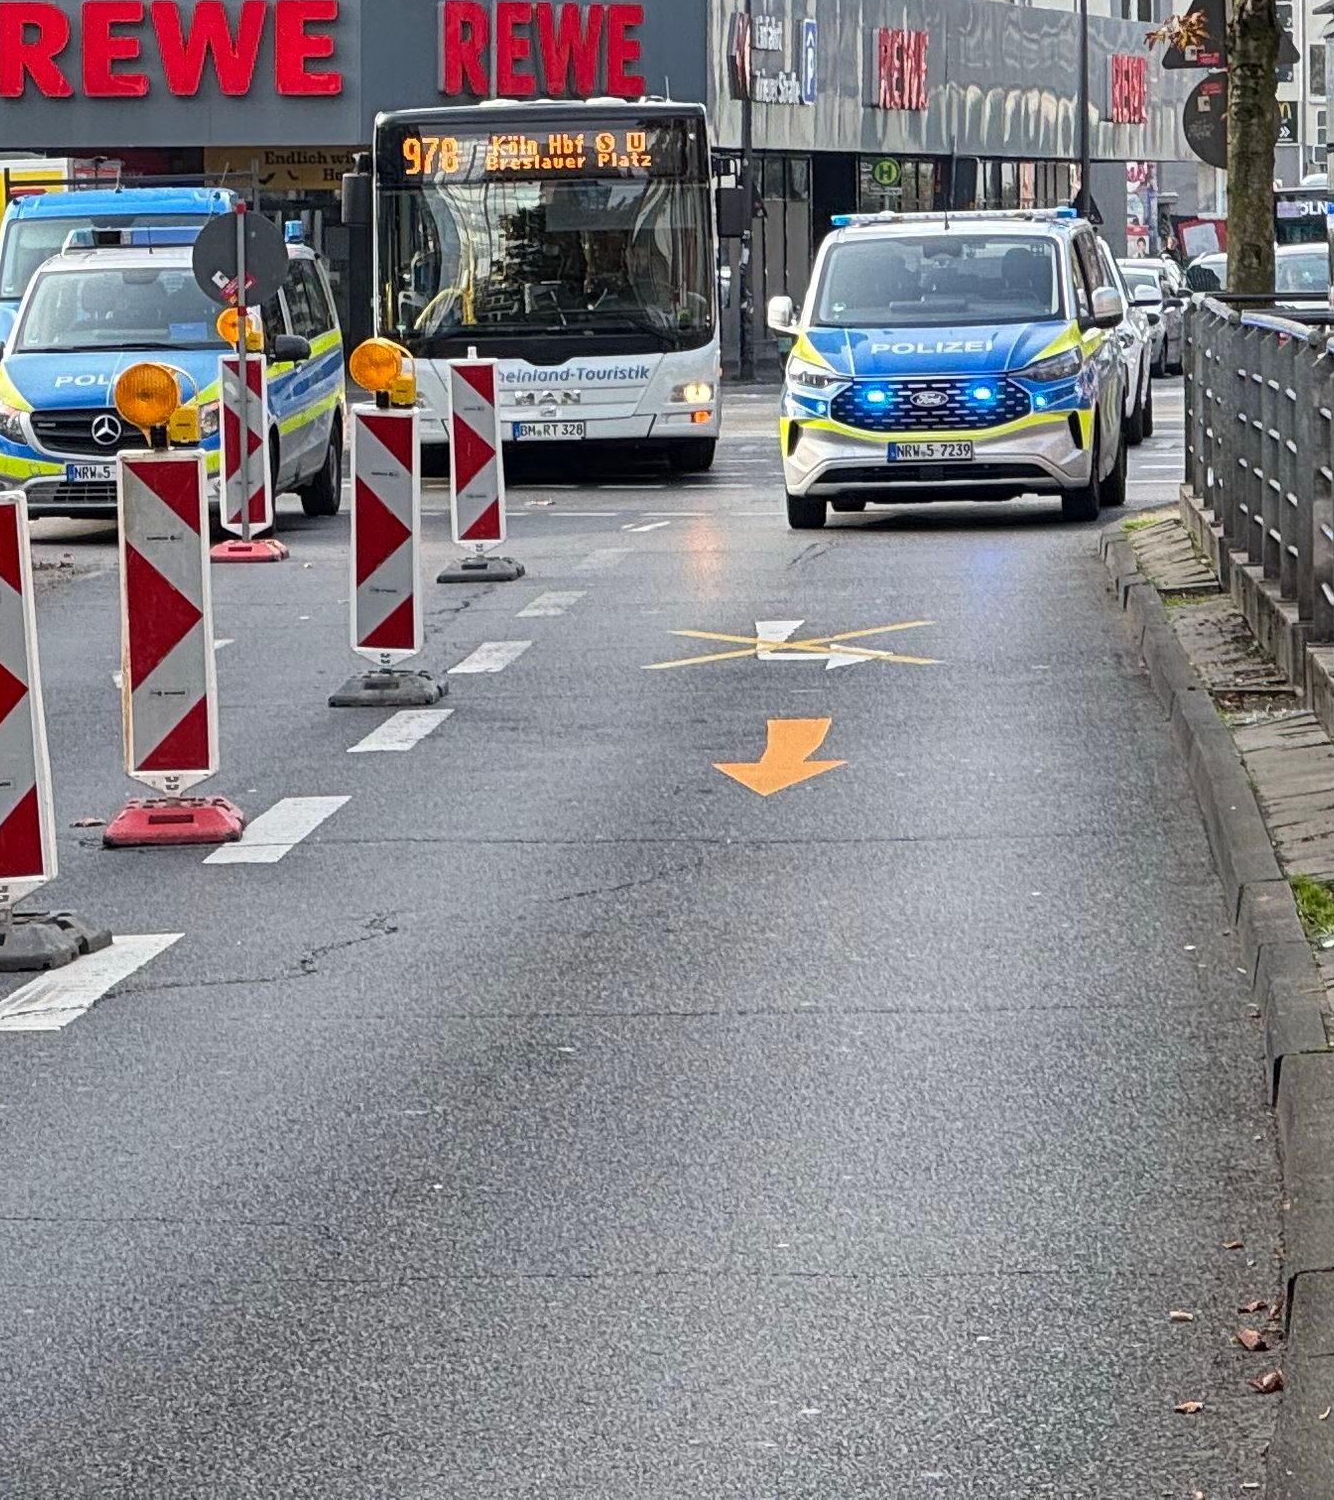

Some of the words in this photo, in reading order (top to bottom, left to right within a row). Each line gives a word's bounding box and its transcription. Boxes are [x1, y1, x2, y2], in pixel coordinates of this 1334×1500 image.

[264, 150, 328, 165] Endlich
[402, 137, 460, 175] 978
[492, 134, 539, 156] Köln
[548, 133, 585, 155] Hbf
[485, 154, 587, 172] Breslauer
[598, 151, 652, 168] Platz
[870, 339, 993, 354] POLIZEI
[498, 365, 650, 384] heinland-Touristik
[520, 423, 536, 437] BM
[543, 423, 558, 437] RT
[561, 423, 584, 436] 328
[897, 444, 921, 458] NRW
[74, 465, 97, 479] NRW
